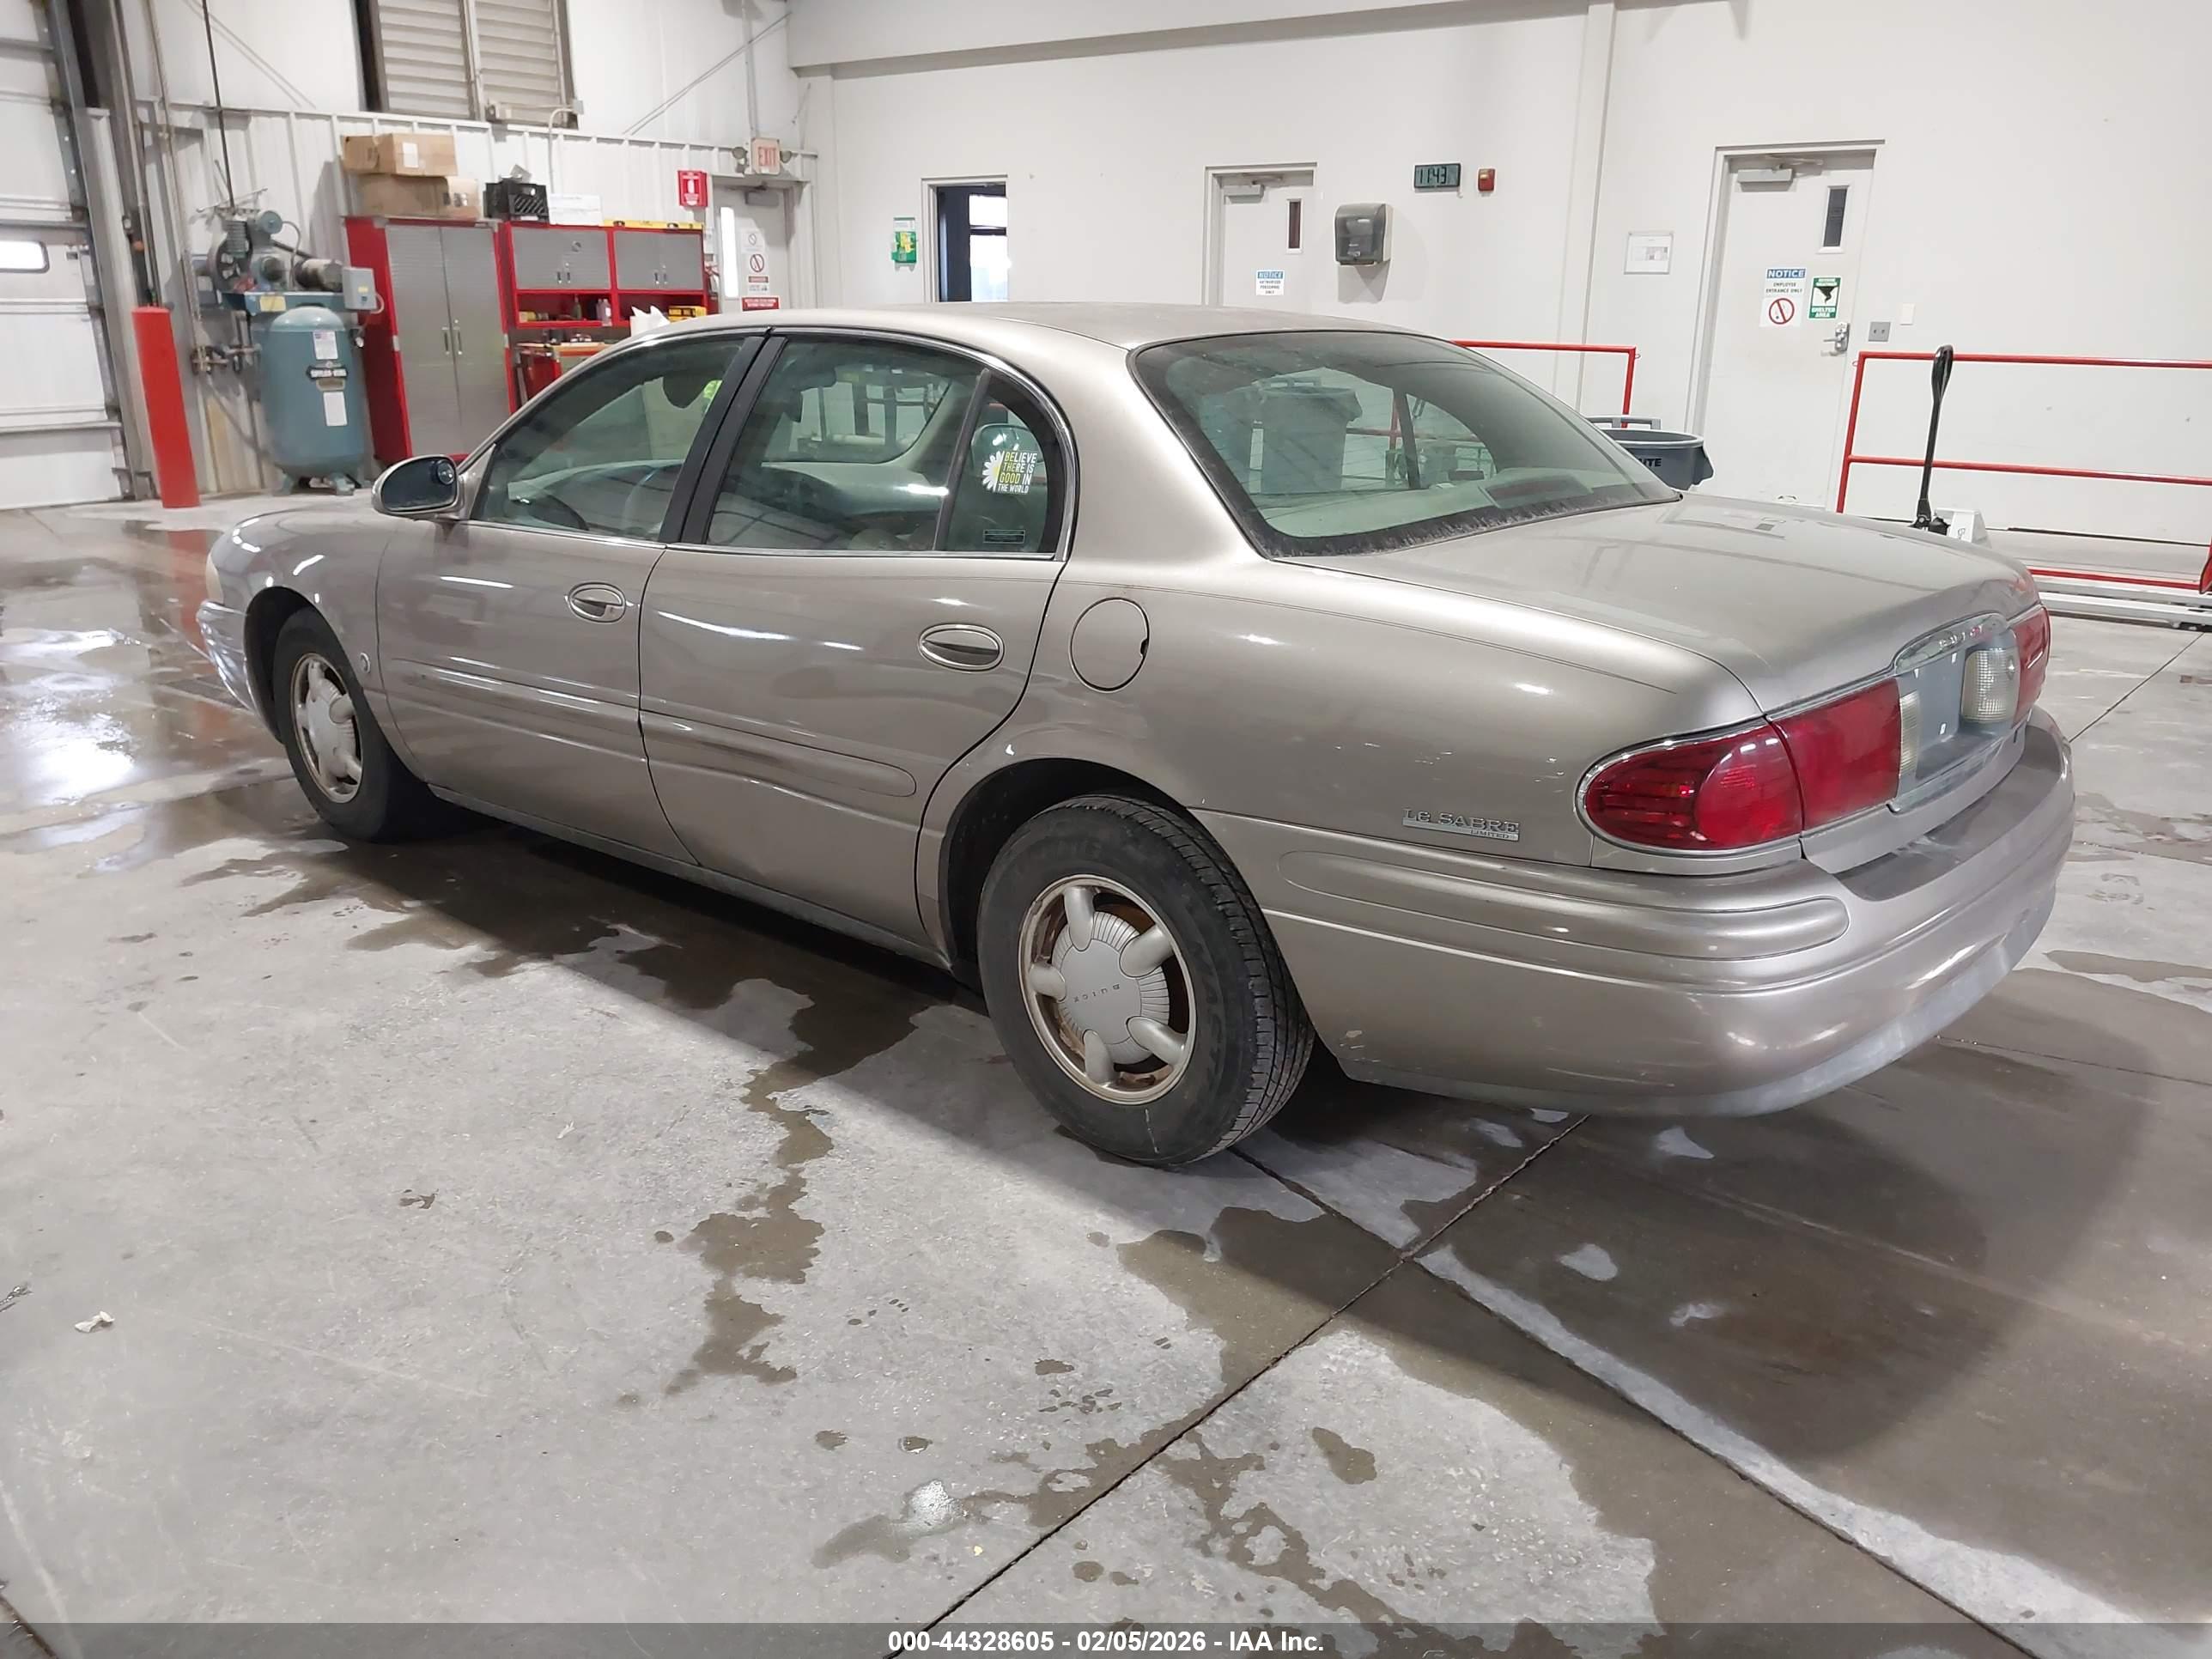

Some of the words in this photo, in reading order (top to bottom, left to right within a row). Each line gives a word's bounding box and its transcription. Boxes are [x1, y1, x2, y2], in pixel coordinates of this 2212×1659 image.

[758, 147, 776, 166] EXIT
[1004, 452, 1037, 464] BELIEVE
[1003, 463, 1025, 473] THERE
[1026, 464, 1035, 474] IS
[1000, 472, 1020, 483] GOOD
[1022, 473, 1032, 485] IN
[998, 483, 1008, 492] THE
[1009, 484, 1030, 494] WORLD
[1438, 811, 1519, 834] SABRE
[1470, 829, 1510, 839] LIMITED
[1073, 983, 1120, 1003] BUICK
